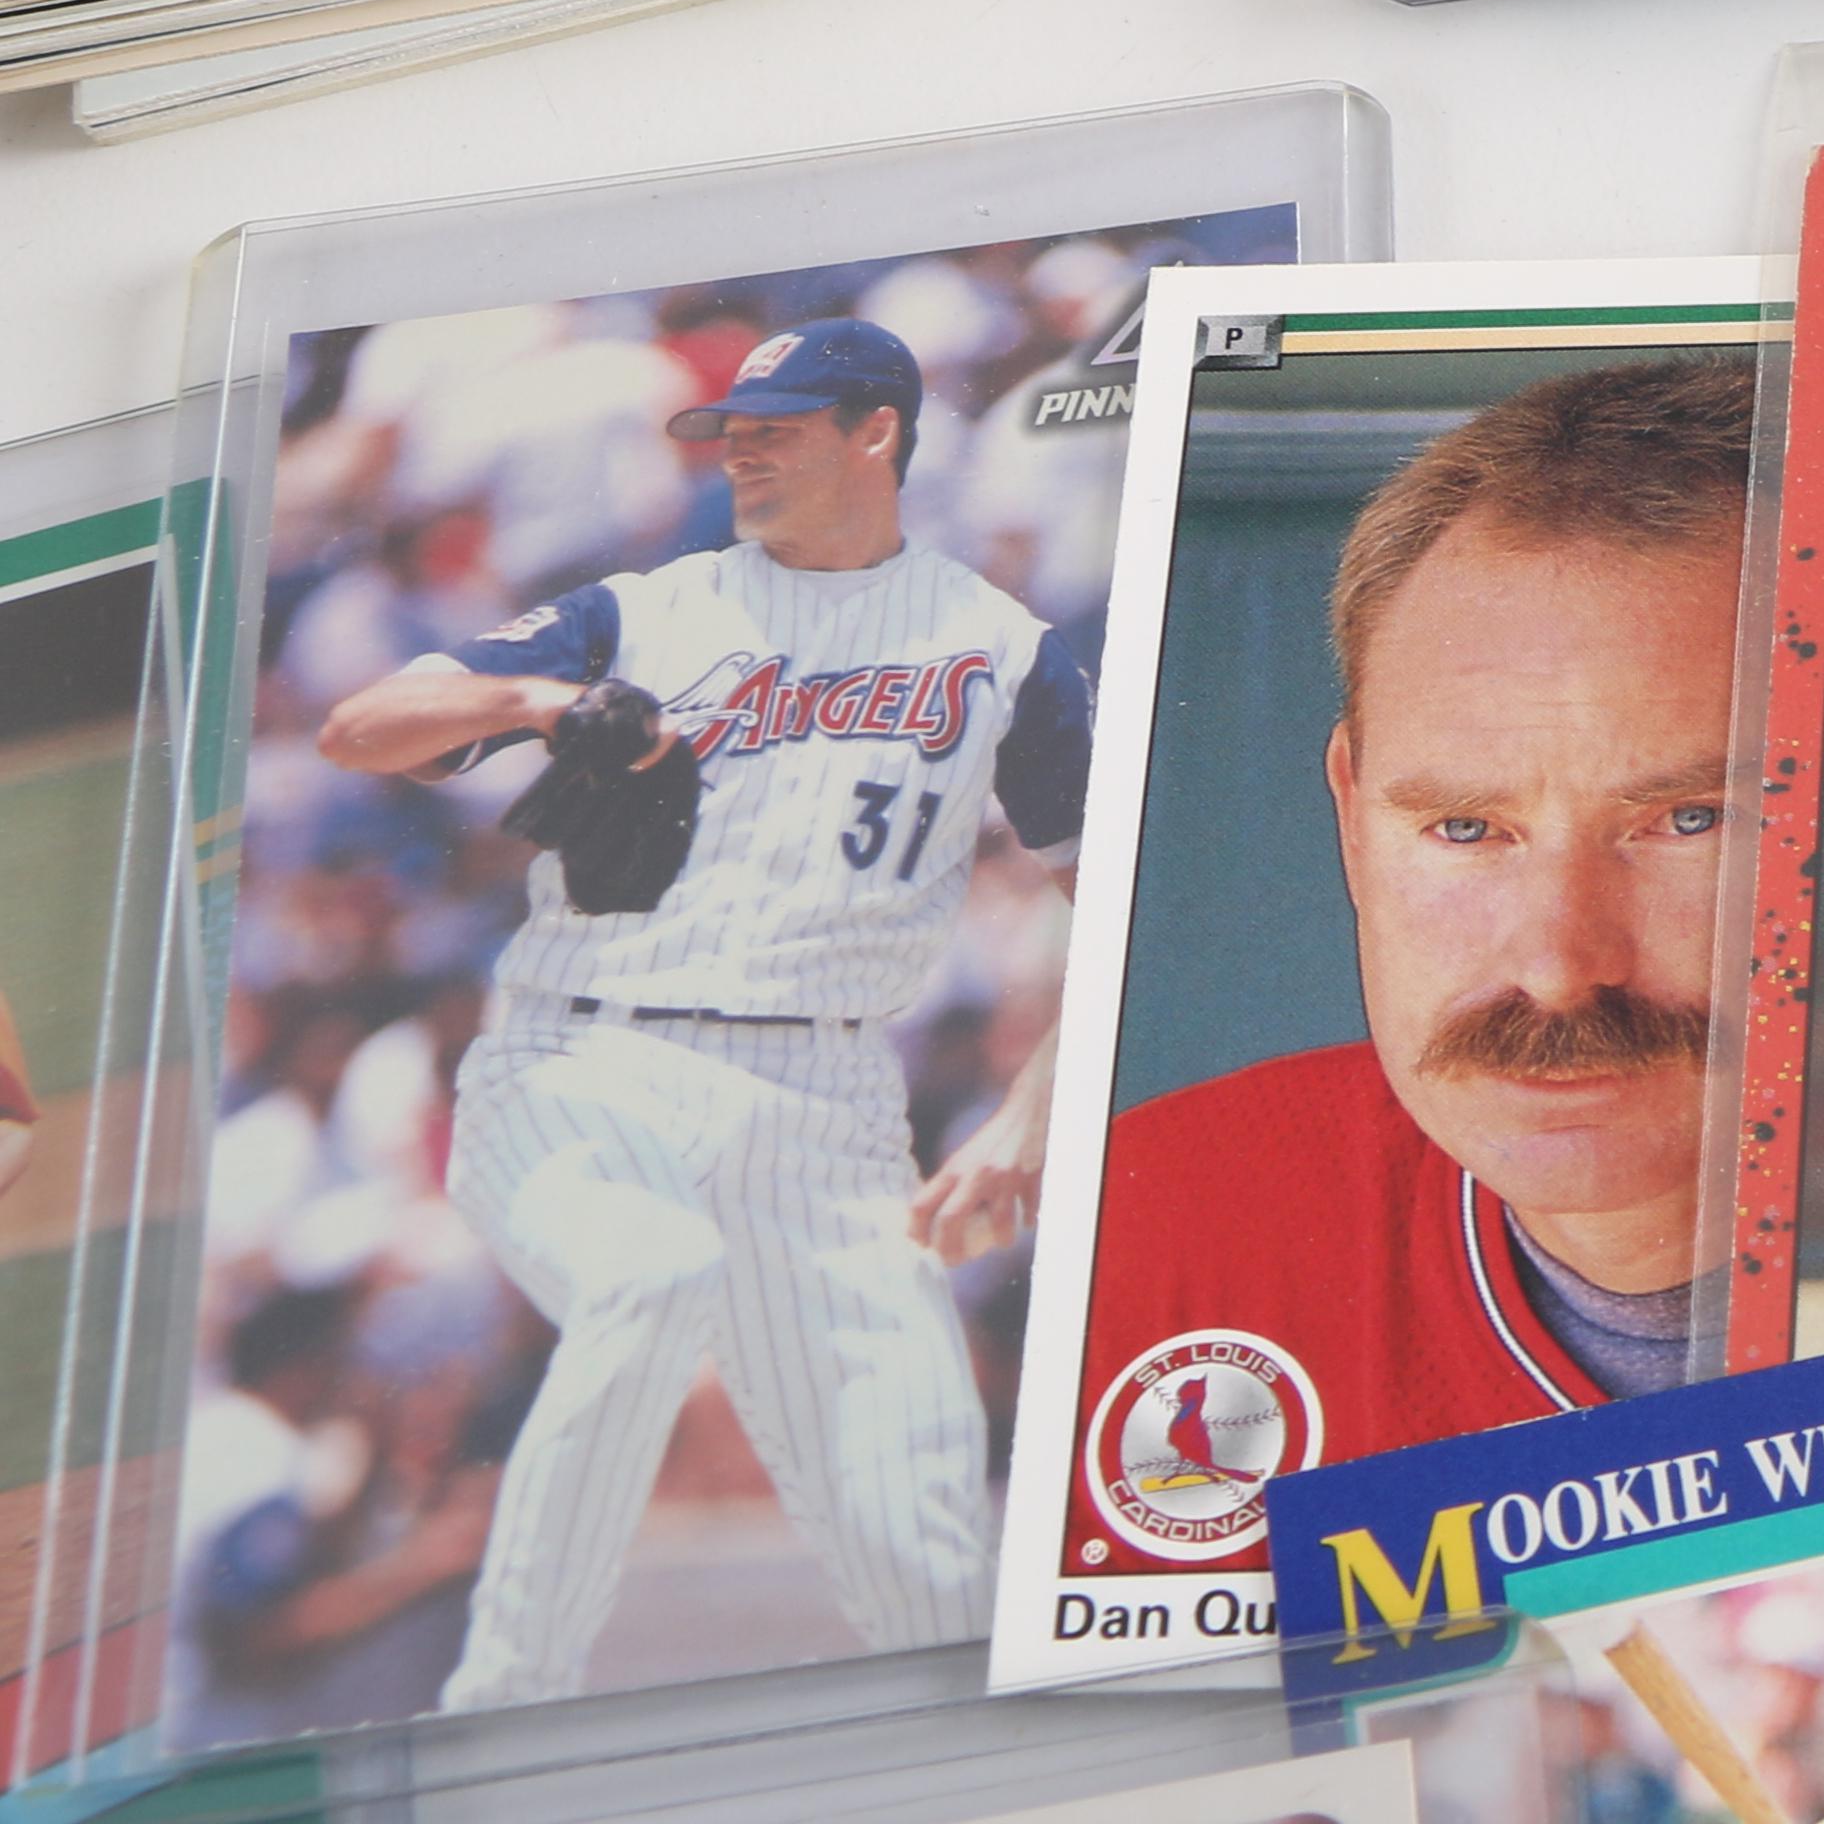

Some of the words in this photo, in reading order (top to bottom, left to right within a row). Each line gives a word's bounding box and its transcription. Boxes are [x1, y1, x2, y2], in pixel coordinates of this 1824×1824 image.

[1225, 327, 1244, 349] P
[1034, 383, 1137, 427] PINN
[840, 780, 943, 881] 31
[1135, 1353, 1181, 1390] ST.
[1190, 1342, 1282, 1386] LOUIS
[1320, 1450, 1728, 1667] MOOKIE
[1054, 1592, 1171, 1641] Dan
[1194, 1588, 1278, 1637] Qu
